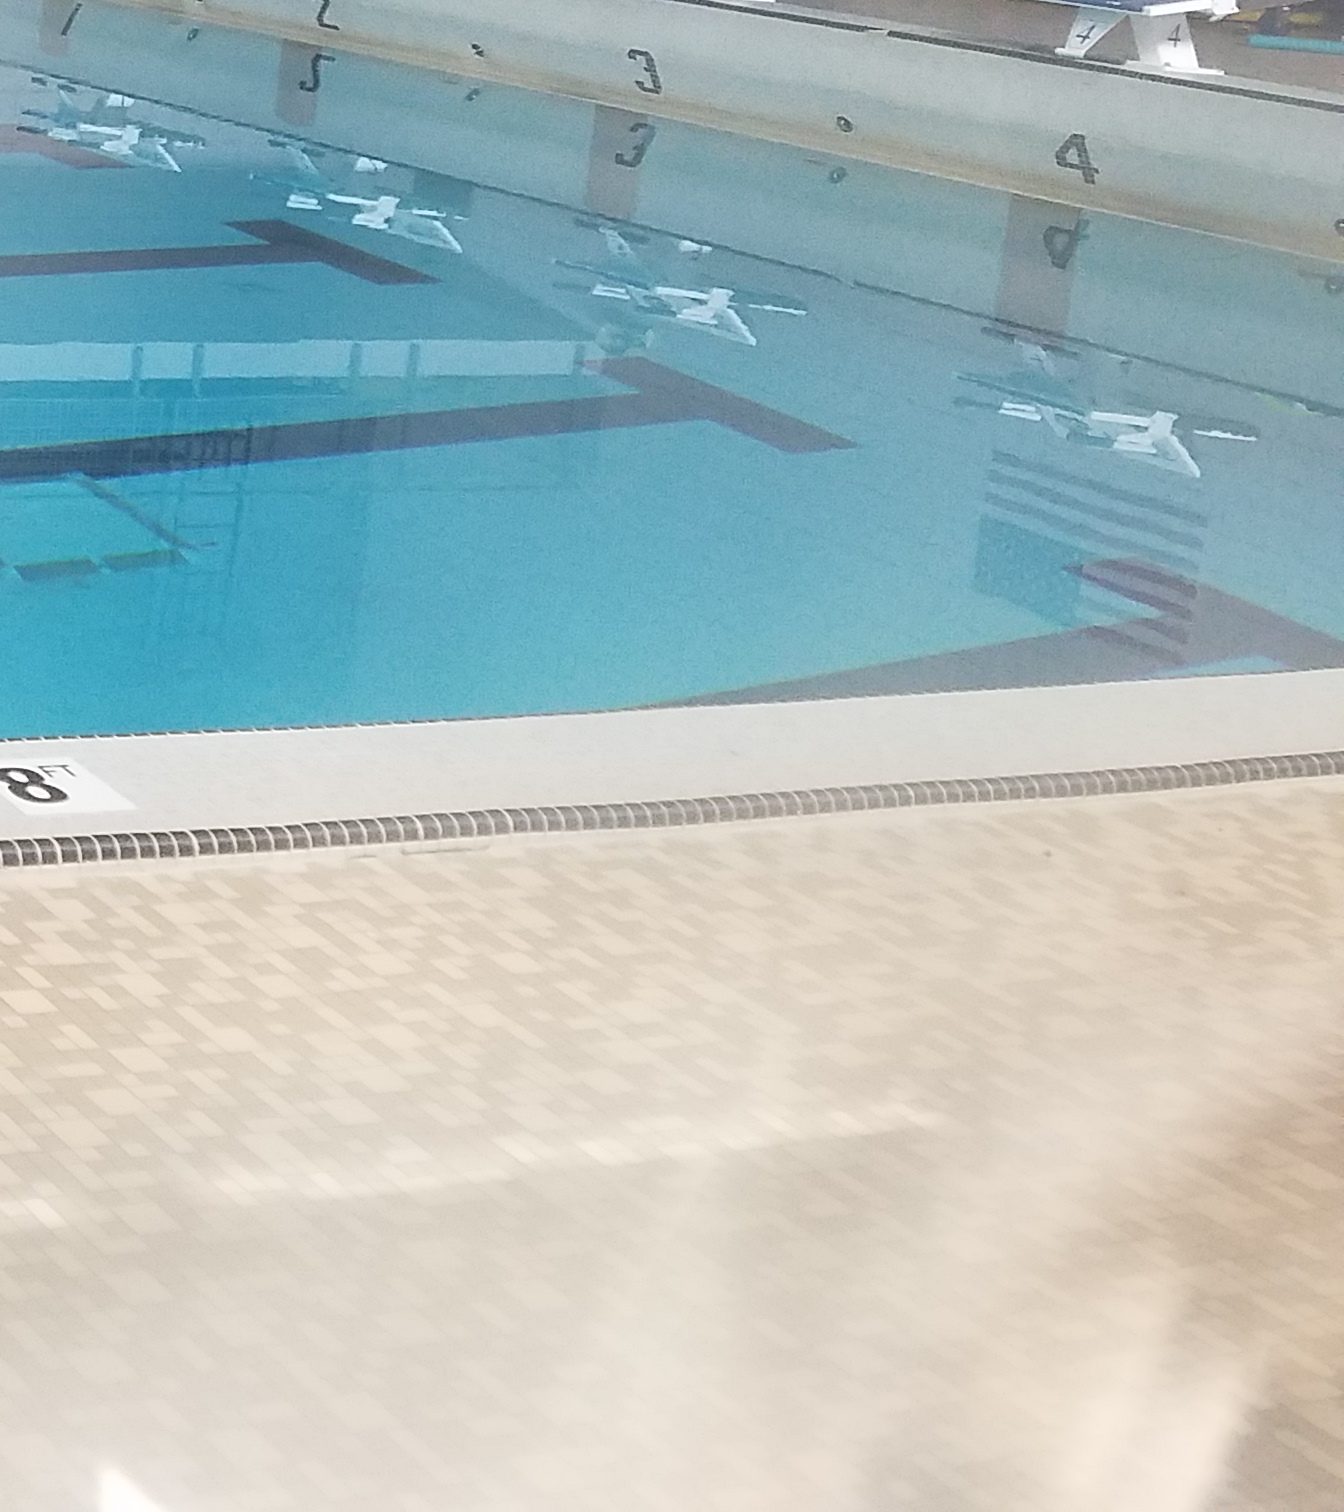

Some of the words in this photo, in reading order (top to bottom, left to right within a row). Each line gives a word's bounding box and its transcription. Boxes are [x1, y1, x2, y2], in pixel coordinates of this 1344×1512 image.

[1075, 24, 1097, 45] 4
[1167, 23, 1182, 48] 4
[627, 48, 662, 95] 3
[1055, 133, 1100, 186] 4
[37, 764, 77, 779] FT
